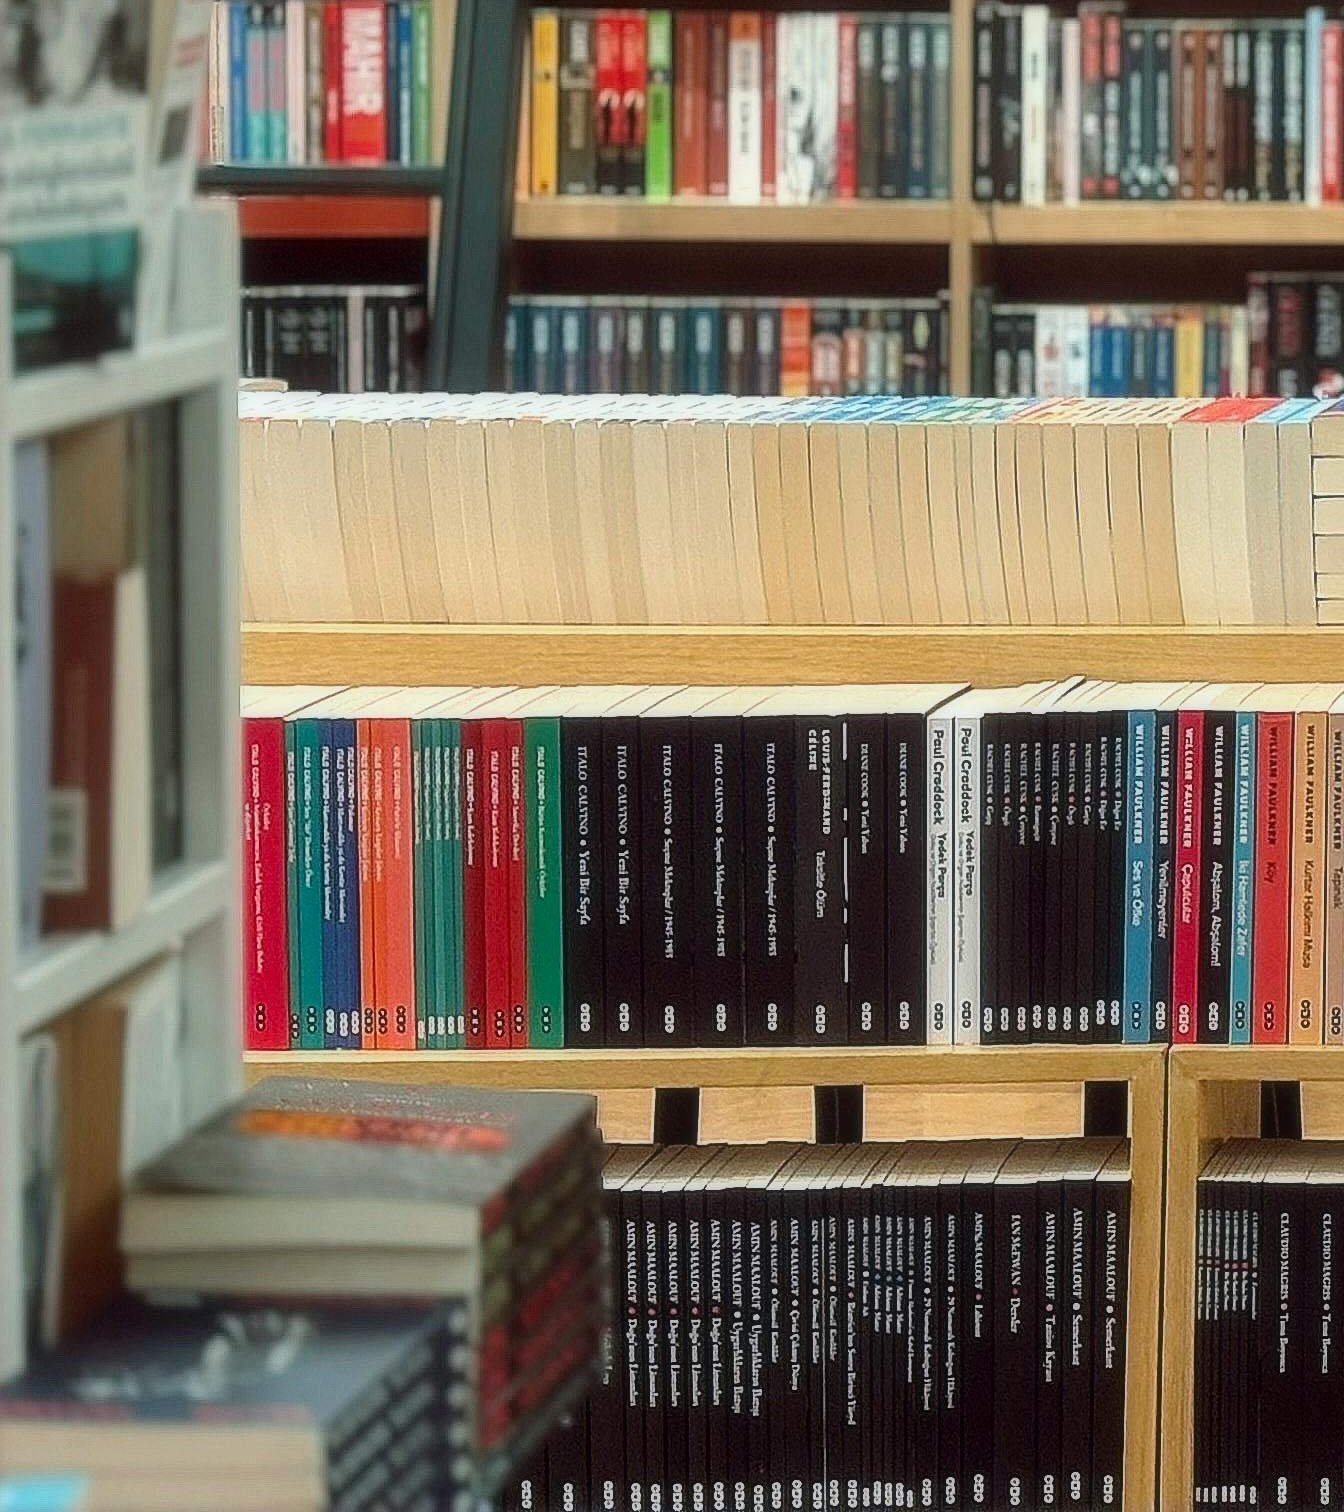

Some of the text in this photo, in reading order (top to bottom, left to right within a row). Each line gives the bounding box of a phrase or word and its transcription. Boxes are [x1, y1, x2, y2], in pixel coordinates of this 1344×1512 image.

[714, 743, 723, 774] ITALO
[933, 730, 944, 758] Paul
[960, 728, 972, 757] Paul
[1134, 724, 1144, 777] WILLIAM
[1159, 725, 1169, 777] WILLIAM
[1214, 726, 1224, 778] WILLIAM
[1239, 724, 1249, 776] WILLIAM
[1305, 725, 1315, 776] WILLIAM
[1333, 731, 1342, 782] WILLIAM
[715, 778, 724, 823] CALVINO
[933, 762, 945, 824] Craddock
[961, 760, 973, 823] Craddock
[1133, 780, 1144, 843] FAULKNER
[1159, 781, 1169, 844] FAULKNER
[1183, 784, 1193, 848] FAULKNER
[1213, 782, 1223, 845] FAULKNER
[1239, 780, 1249, 843] FAULKNER
[1305, 780, 1314, 843] FAULKNER
[1333, 787, 1342, 849] FAULKNER
[577, 746, 591, 925] ITALO CALVINO Yeni Bir Sayfa
[616, 746, 630, 924] ITALO CALVINO Yeni Bir Sayfa
[1132, 861, 1143, 880] Ses
[1105, 1210, 1116, 1242] AMIN
[1105, 1244, 1116, 1301] MAALOUF
